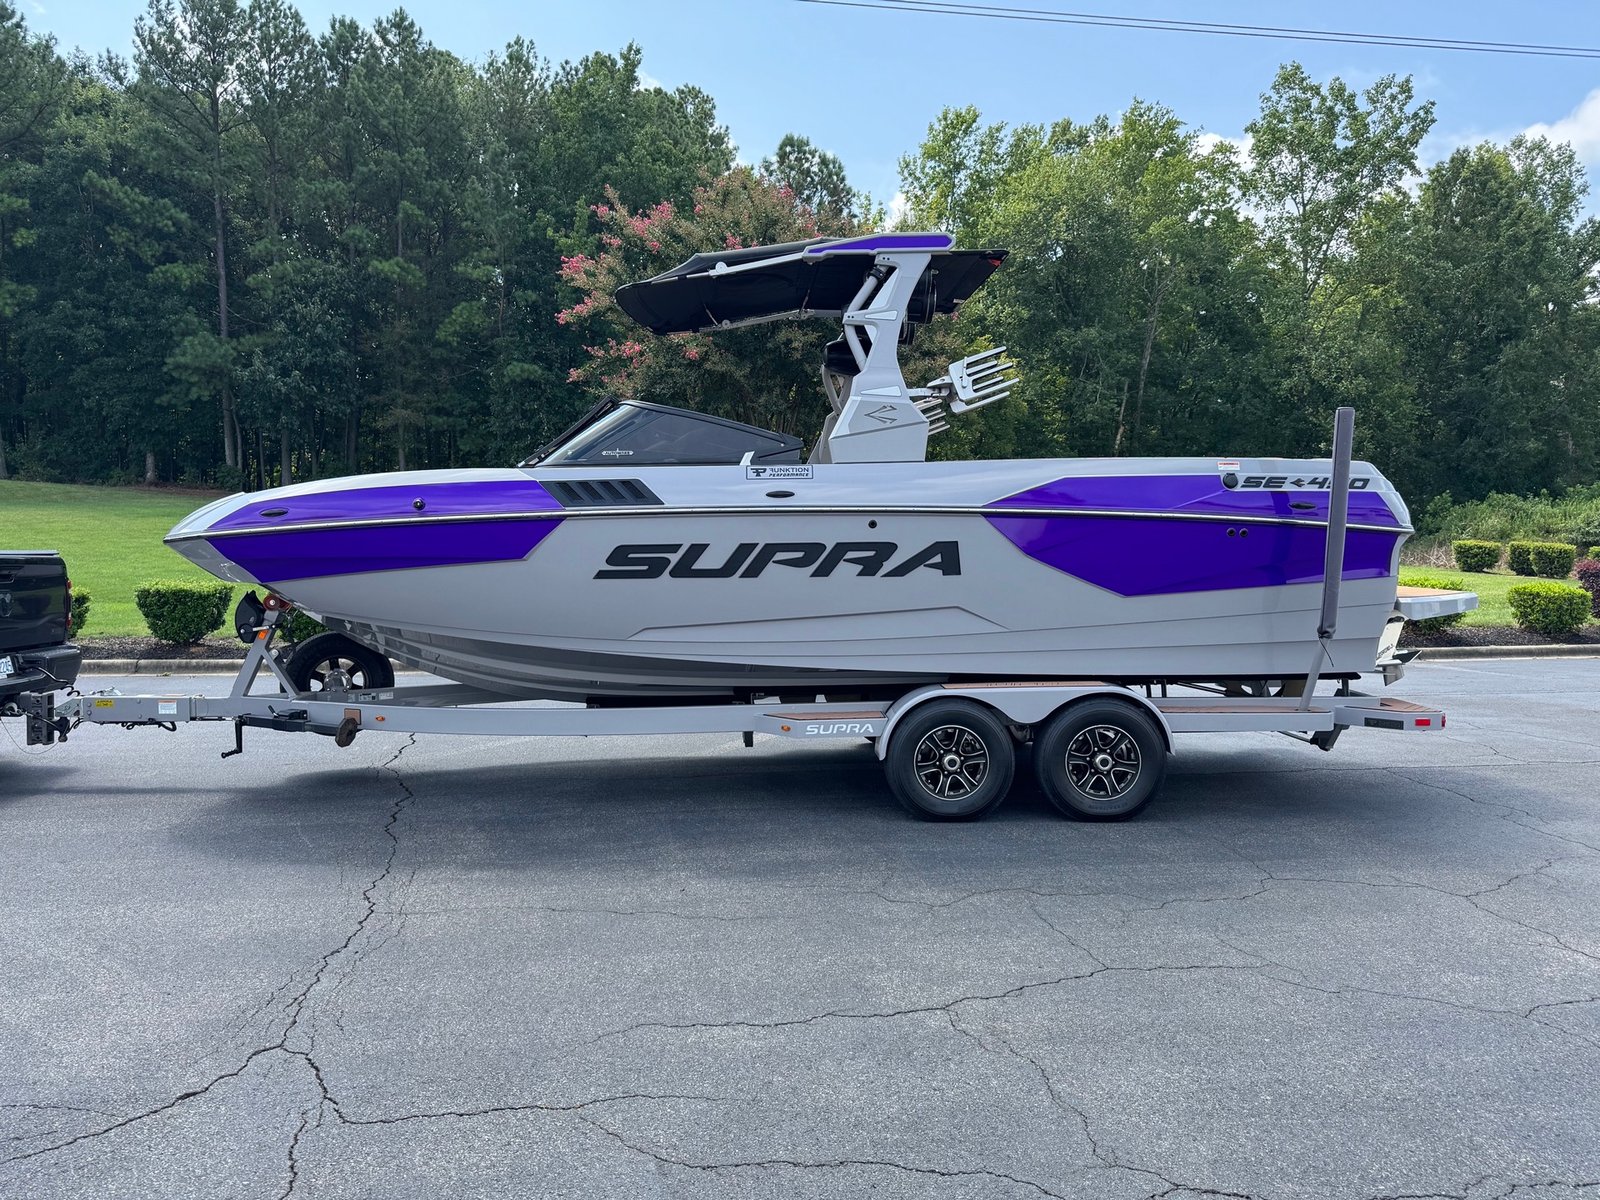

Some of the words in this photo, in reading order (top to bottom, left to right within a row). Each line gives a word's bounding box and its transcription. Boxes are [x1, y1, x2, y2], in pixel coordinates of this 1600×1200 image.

[1240, 476, 1288, 489] SE
[1307, 477, 1371, 490] 40
[592, 541, 962, 579] SUPRA
[805, 723, 874, 735] SUPRA
